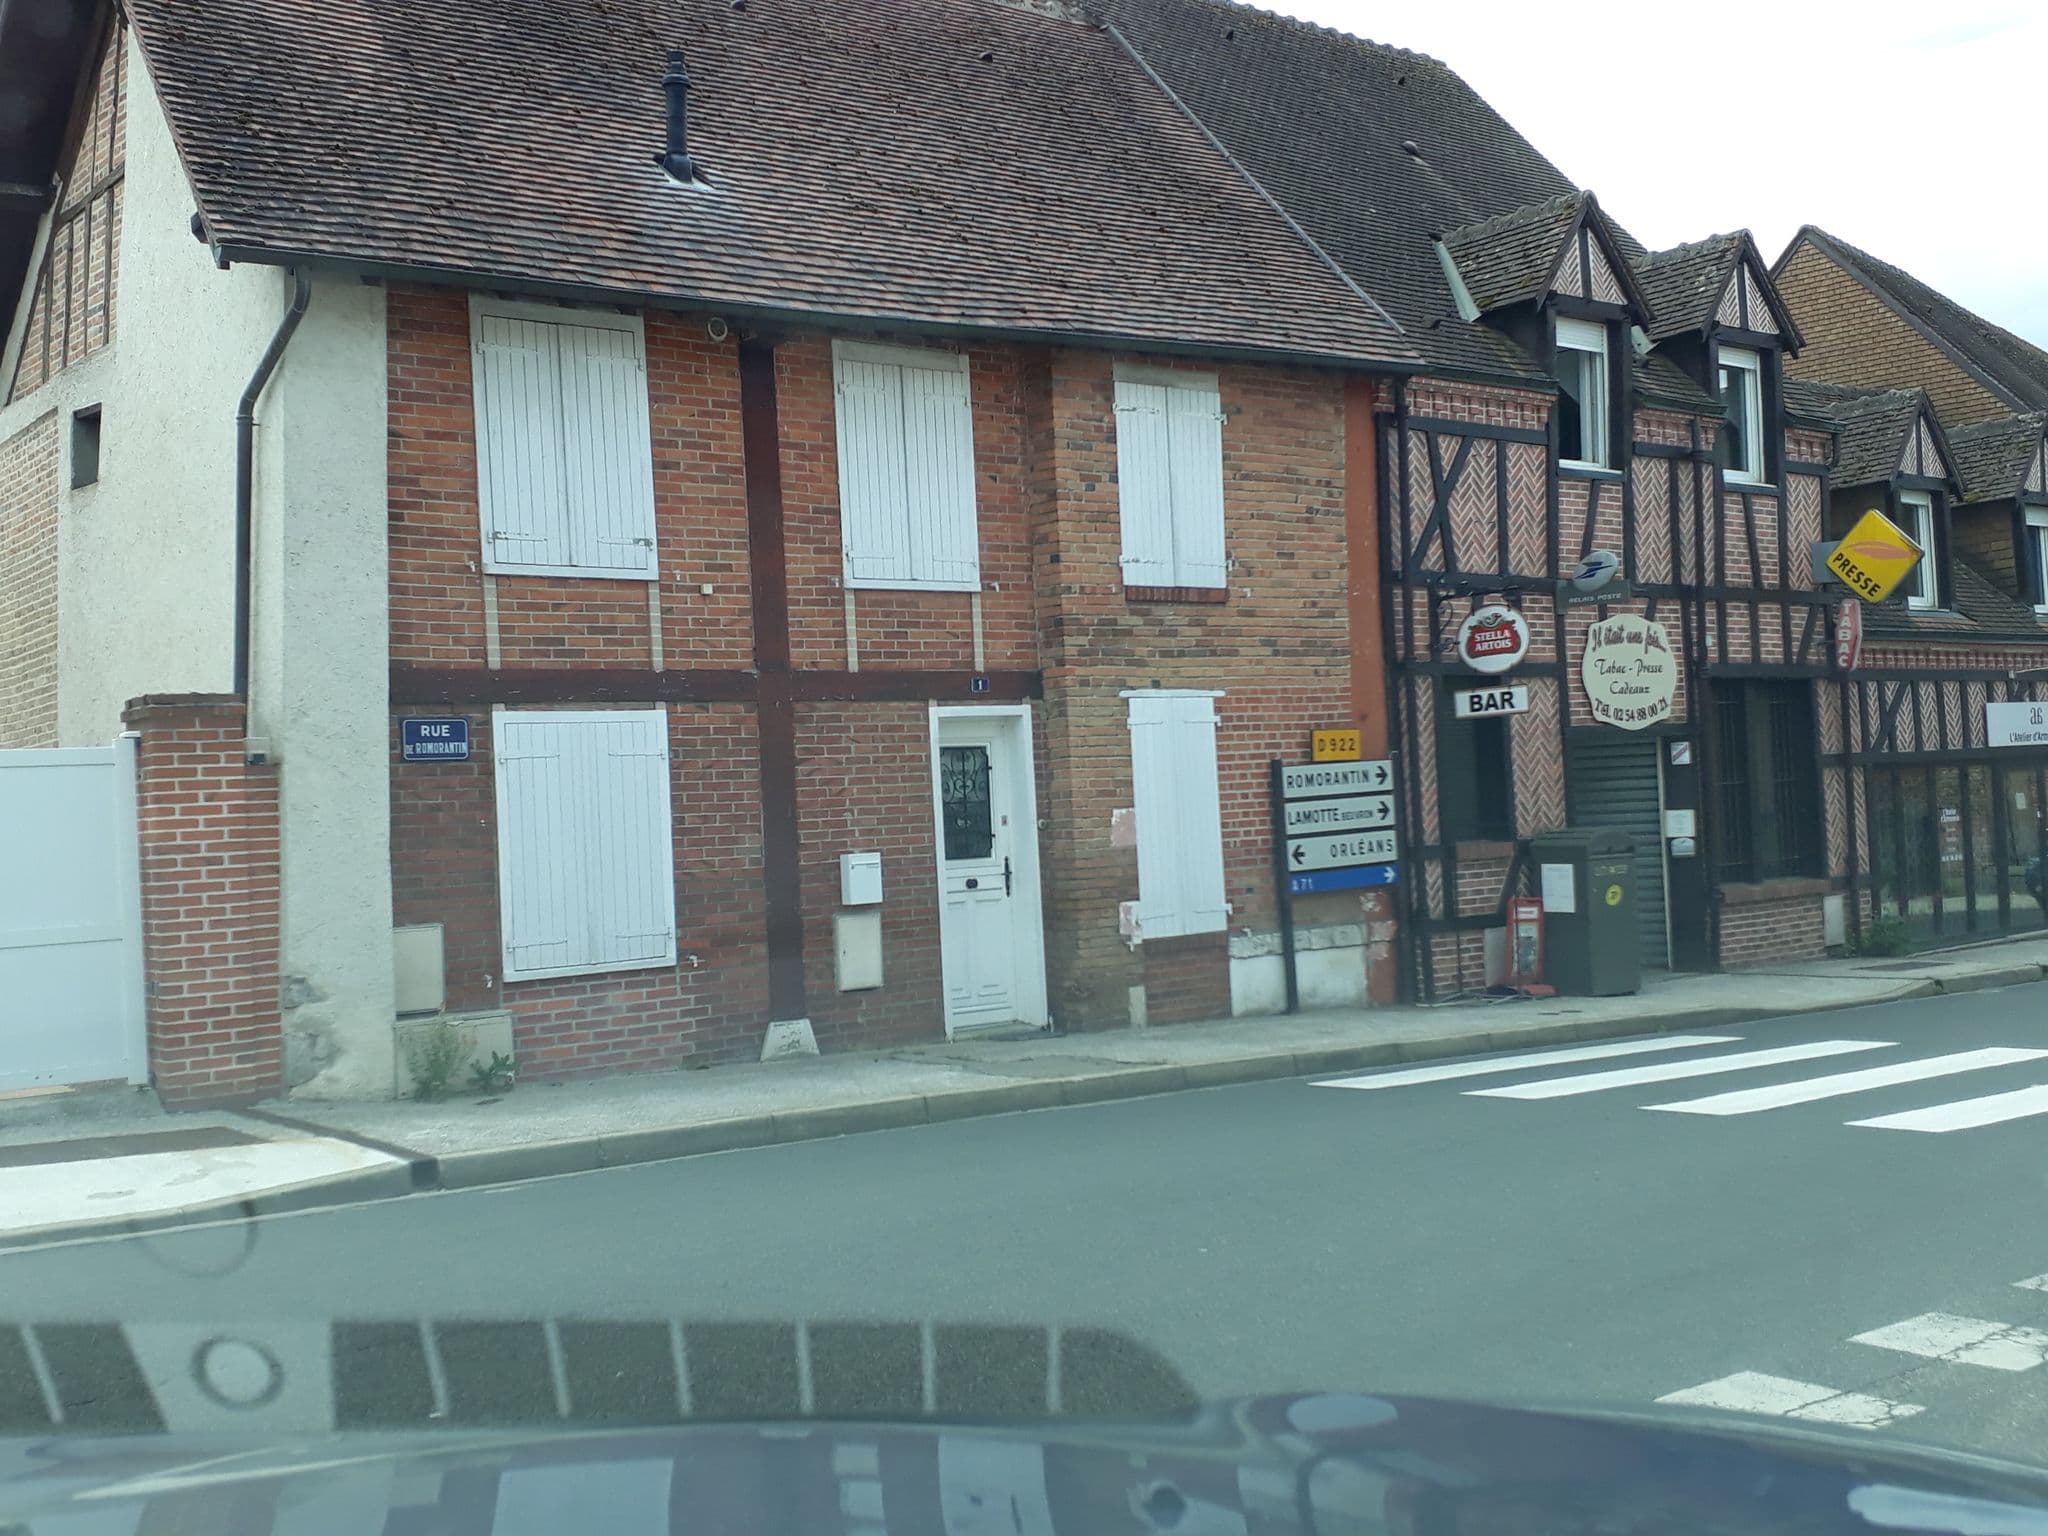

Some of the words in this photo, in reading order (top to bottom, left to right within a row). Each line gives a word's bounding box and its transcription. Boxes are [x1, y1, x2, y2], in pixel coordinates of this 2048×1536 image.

[1832, 552, 1882, 597] PRESSE
[1568, 595, 1595, 603] RELAIS
[1597, 592, 1622, 601] POSTE
[1474, 630, 1512, 643] STELLA
[1837, 602, 1853, 668] TABAC
[1474, 639, 1513, 652] ARTOIS
[1594, 658, 1626, 676] Tabac
[1634, 658, 1664, 677] Presse
[977, 679, 983, 691] 1
[1609, 680, 1651, 695] Cadeaux
[1469, 691, 1515, 713] BAR
[1613, 707, 1624, 721] 02
[1625, 707, 1634, 721] 54
[1636, 707, 1647, 720] 88
[1647, 703, 1658, 717] 00
[420, 724, 451, 737] RUE
[415, 741, 467, 754] ROMORANTIN
[1286, 769, 1371, 789] ROMORANTIN
[1287, 807, 1340, 826] LAMOTTE
[1329, 838, 1394, 858] ORLÉANS
